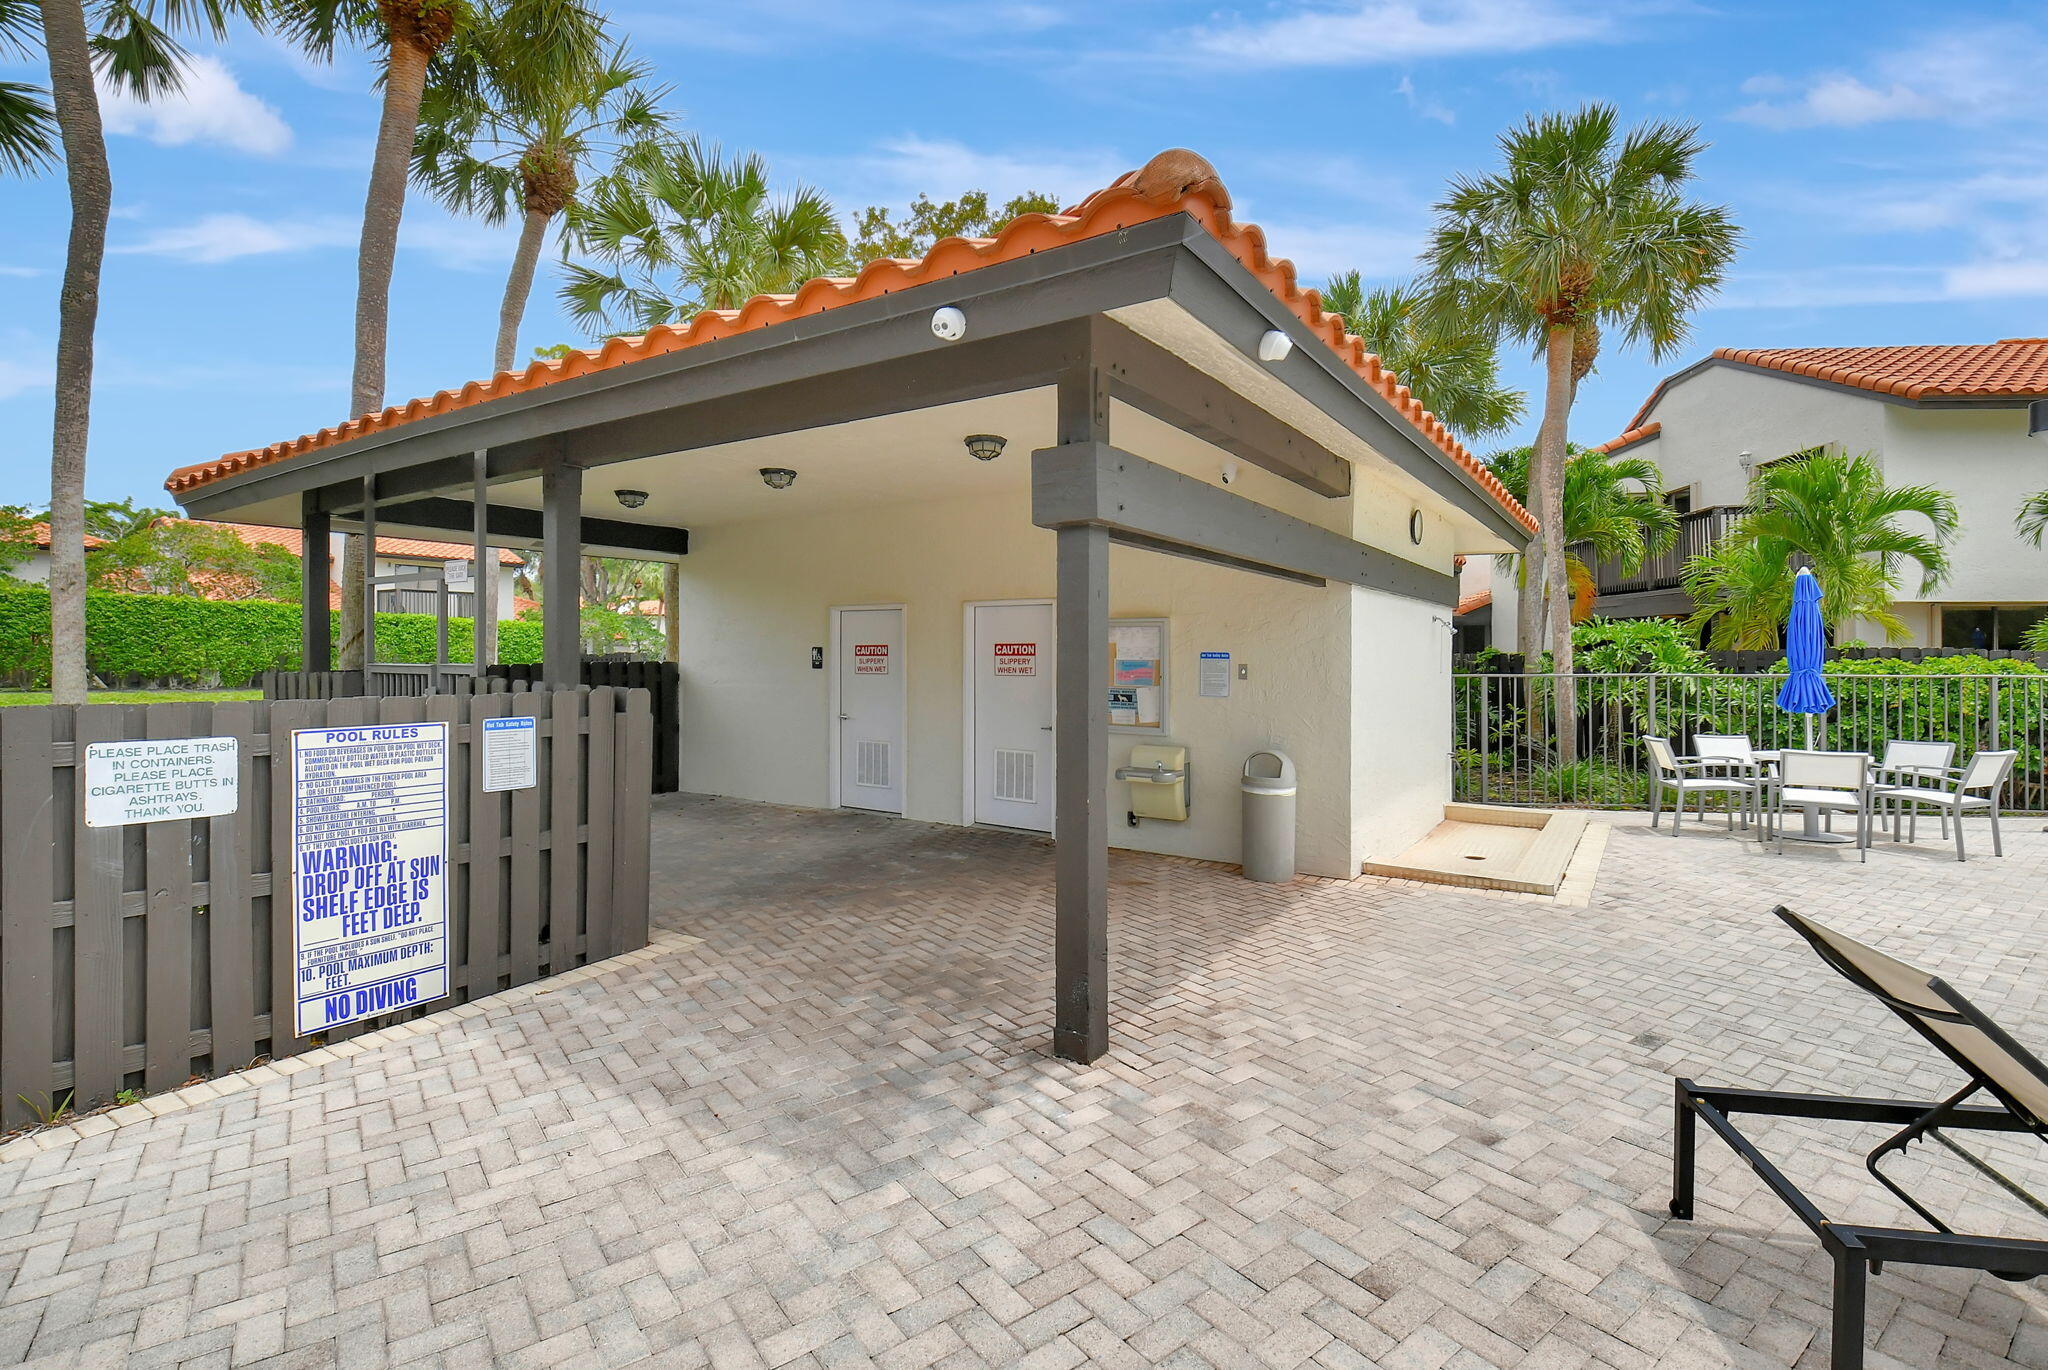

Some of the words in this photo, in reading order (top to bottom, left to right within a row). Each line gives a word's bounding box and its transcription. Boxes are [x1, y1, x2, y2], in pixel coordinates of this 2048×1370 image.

[856, 646, 887, 655] CAUTION
[995, 645, 1034, 654] CAUTION
[326, 731, 366, 743] POOL
[372, 728, 418, 740] RULES
[89, 747, 142, 759] PLEASE
[147, 745, 189, 756] PLACE
[194, 742, 235, 753] TRASH
[304, 756, 346, 765] COMMERCIALLY
[370, 752, 388, 760] WATER
[395, 750, 415, 758] PLASTIC
[337, 747, 366, 755] BEVERAGES
[130, 755, 215, 769] CONTAINERS.
[304, 764, 330, 772] ALLOWED
[114, 770, 167, 782] PLEASE
[172, 767, 213, 778] PLACE
[315, 780, 332, 788] GLASS
[341, 777, 365, 785] ANIMALS
[415, 771, 427, 779] AREA
[91, 781, 170, 796] CIGARETTE
[175, 778, 218, 790] BUTTS
[222, 777, 234, 786] IN
[326, 786, 338, 794] FEET
[339, 785, 353, 793] FROM
[354, 782, 380, 792] UNFENCED
[129, 791, 202, 806] ASHTRAYS.
[306, 797, 329, 805] BATHING
[125, 806, 170, 818] THANK
[177, 803, 205, 813] YOU.
[306, 815, 329, 824] SHOWER
[330, 813, 349, 821] BEFORE
[315, 824, 325, 832] NOT
[327, 821, 353, 831] SWALLOW
[365, 817, 378, 825] POOL
[305, 834, 312, 842] DO
[314, 833, 324, 841] NOT
[337, 830, 350, 838] POOL
[387, 823, 401, 831] WITH
[324, 841, 337, 849] POOL
[339, 837, 364, 847] INCLUDES
[302, 840, 398, 874] WARNING:
[303, 869, 349, 899] DROP
[354, 864, 382, 889] OFF
[387, 860, 406, 884] AT
[410, 855, 440, 880] SUN
[303, 890, 359, 922] SHELF
[364, 881, 408, 911] EDGE
[412, 878, 429, 901] IS
[342, 909, 378, 937] FEET
[383, 901, 422, 930] DEEP.
[314, 949, 324, 957] THE
[324, 946, 338, 955] POOL
[339, 941, 365, 952] INCLUDES
[409, 928, 418, 936] NOT
[419, 925, 434, 934] PLACE
[301, 968, 316, 982] 10.
[319, 961, 345, 978] POOL
[348, 949, 398, 972] MAXIMUM
[400, 942, 433, 960] DEPTH:
[307, 954, 337, 966] FURNITURE
[326, 973, 351, 990] FEET.
[325, 994, 351, 1023] NO
[356, 977, 417, 1015] DIVING
